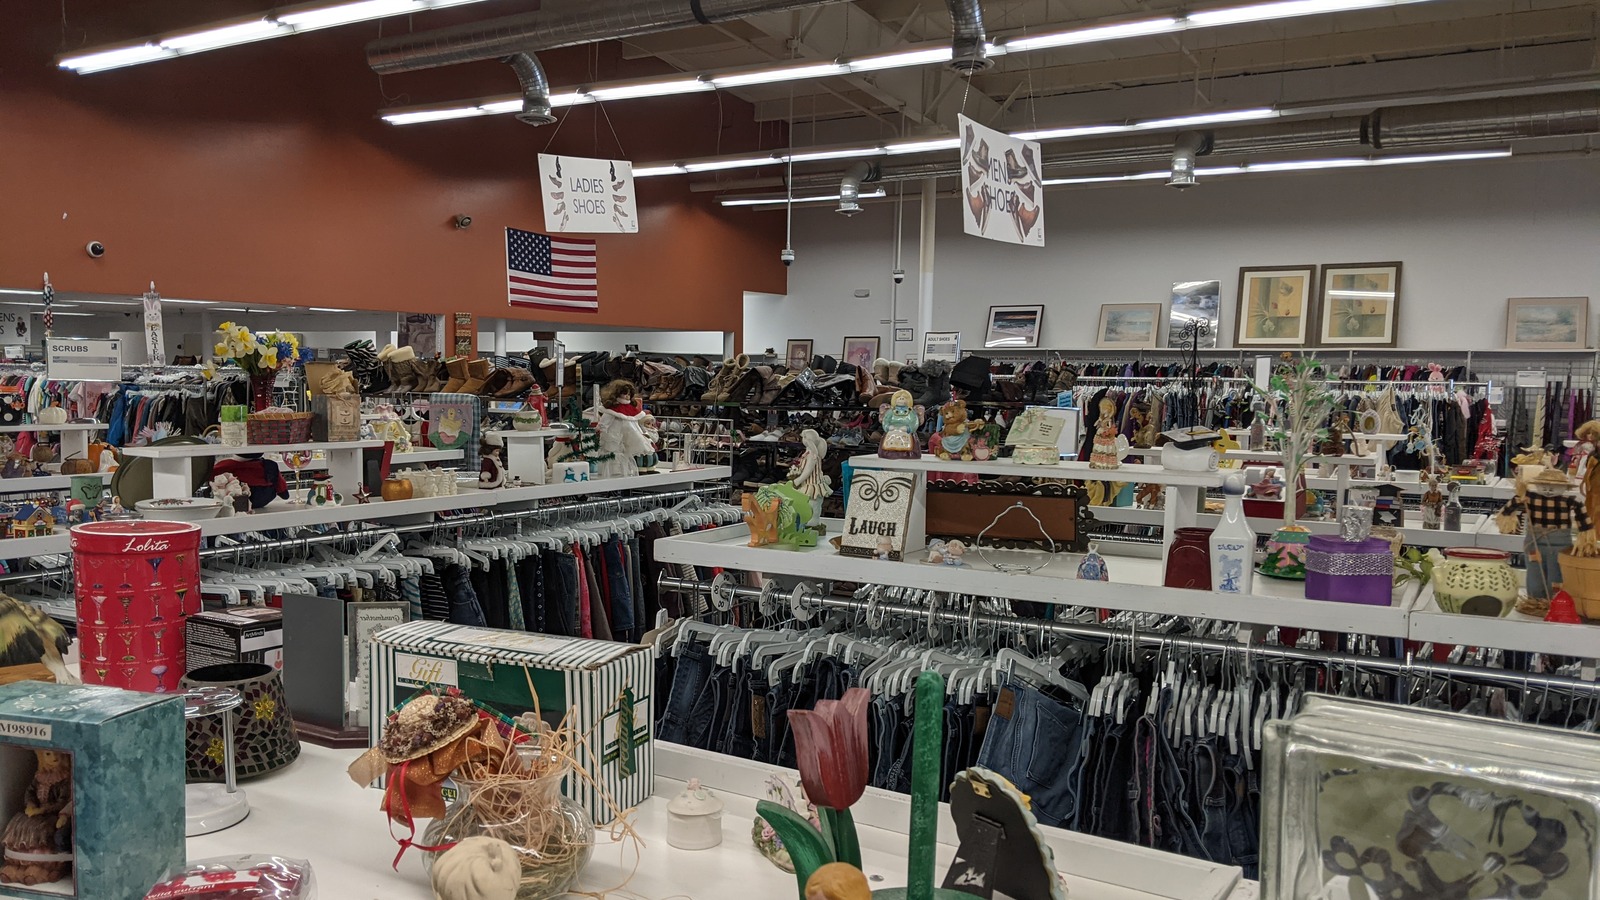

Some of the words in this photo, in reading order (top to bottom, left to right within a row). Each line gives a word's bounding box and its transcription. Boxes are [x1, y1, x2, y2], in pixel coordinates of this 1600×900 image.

[569, 177, 605, 194] LADIES
[572, 198, 606, 215] SHOES
[150, 323, 160, 361] EASTER
[122, 537, 171, 553] Lolita
[408, 657, 444, 688] Gift
